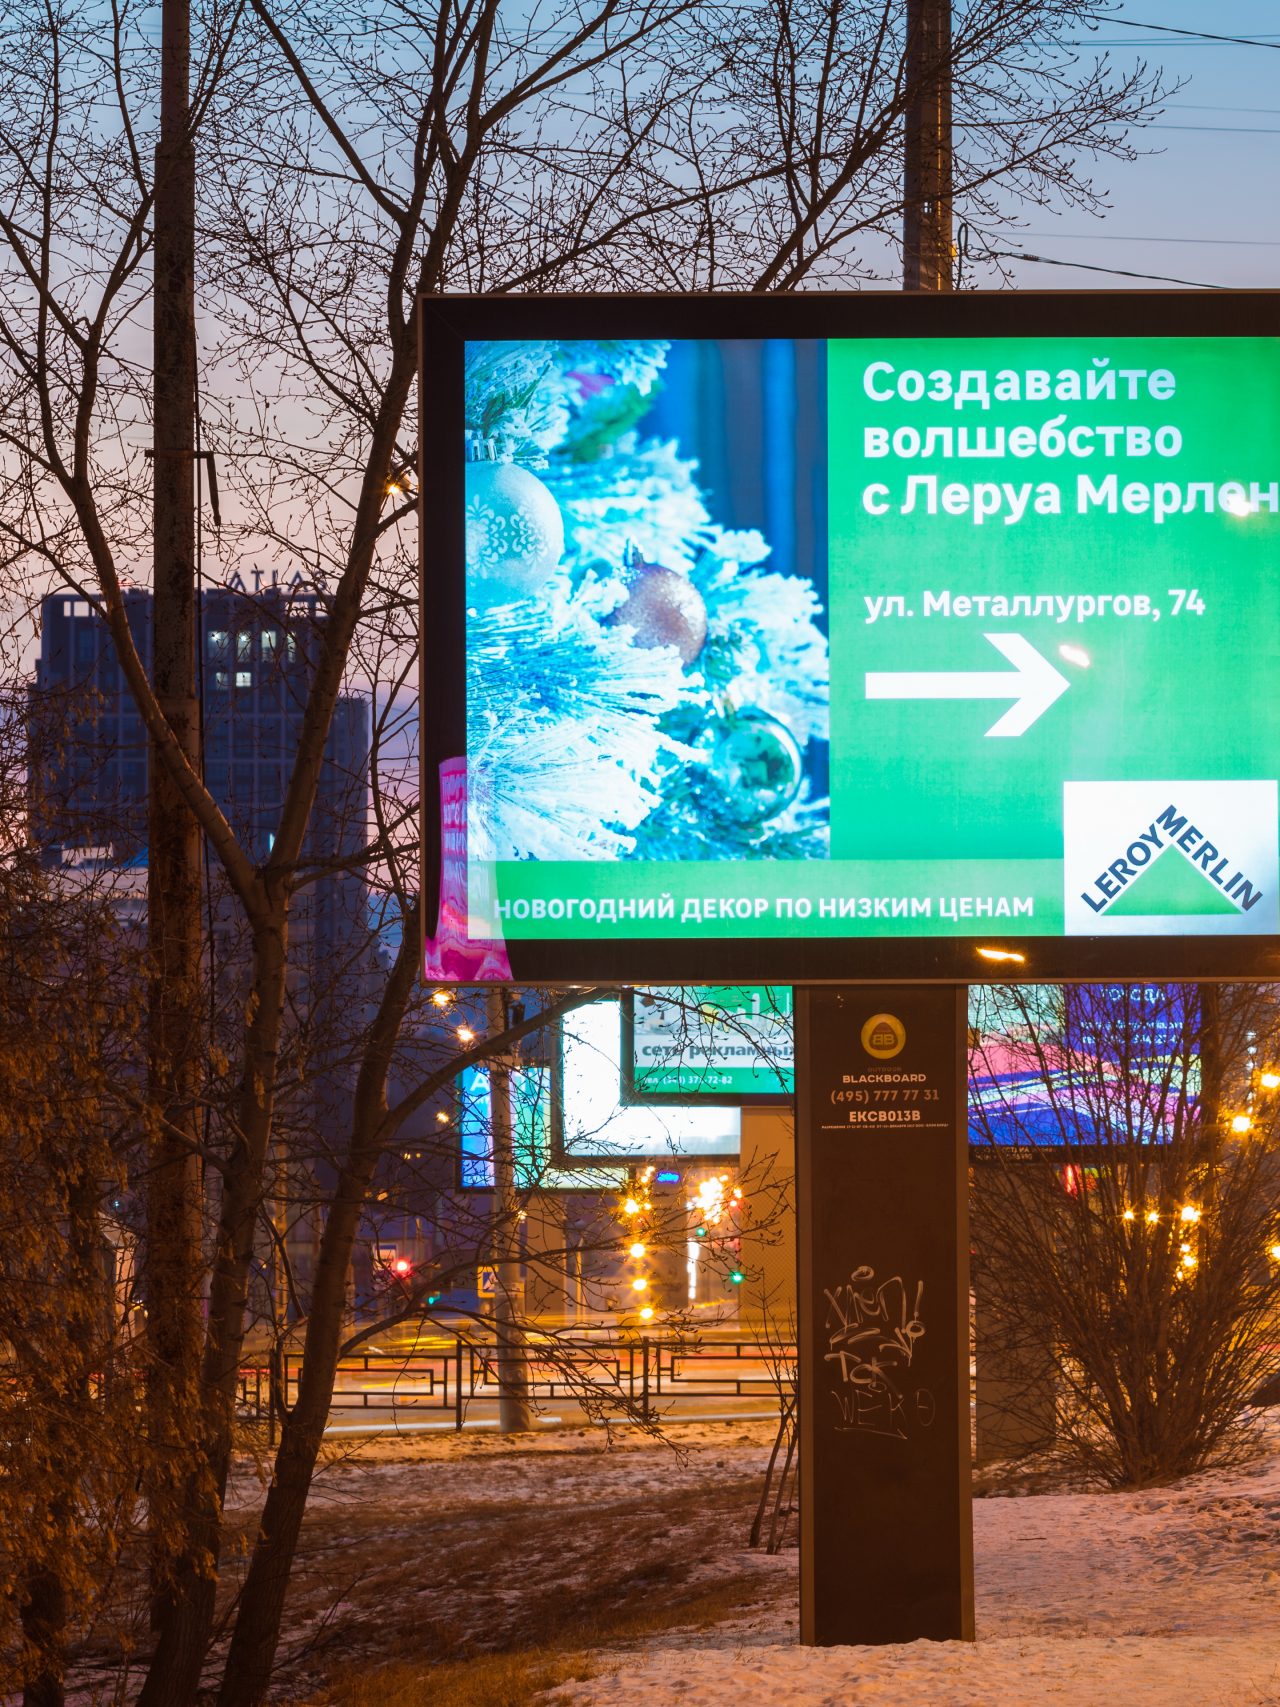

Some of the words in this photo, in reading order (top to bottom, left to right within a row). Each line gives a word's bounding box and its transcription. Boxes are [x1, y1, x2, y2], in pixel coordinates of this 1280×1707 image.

[863, 357, 1176, 410] Создавайте
[863, 414, 1183, 458] волшебство
[862, 482, 890, 515] с
[901, 475, 1061, 525] Леруа
[1078, 474, 1280, 524] Мерлен
[864, 595, 914, 624] ул.
[923, 590, 1161, 623] Металлургов,
[1168, 589, 1206, 616] 74
[1080, 823, 1165, 913] LEROY
[1156, 804, 1264, 911] MERLIN
[493, 893, 675, 924] НОВОГОДНИЙ
[681, 898, 769, 924] ДЕКОР
[775, 897, 812, 919] ПО
[819, 897, 932, 919] НИЗКИМ
[939, 896, 1034, 922] ЦЕНАМ
[831, 1090, 869, 1104] (495)
[873, 1090, 898, 1102] 777
[902, 1089, 919, 1101] 77
[923, 1089, 940, 1100] 31
[842, 1074, 927, 1084] BLACKBOARD
[849, 1110, 921, 1122] EKCB013B
